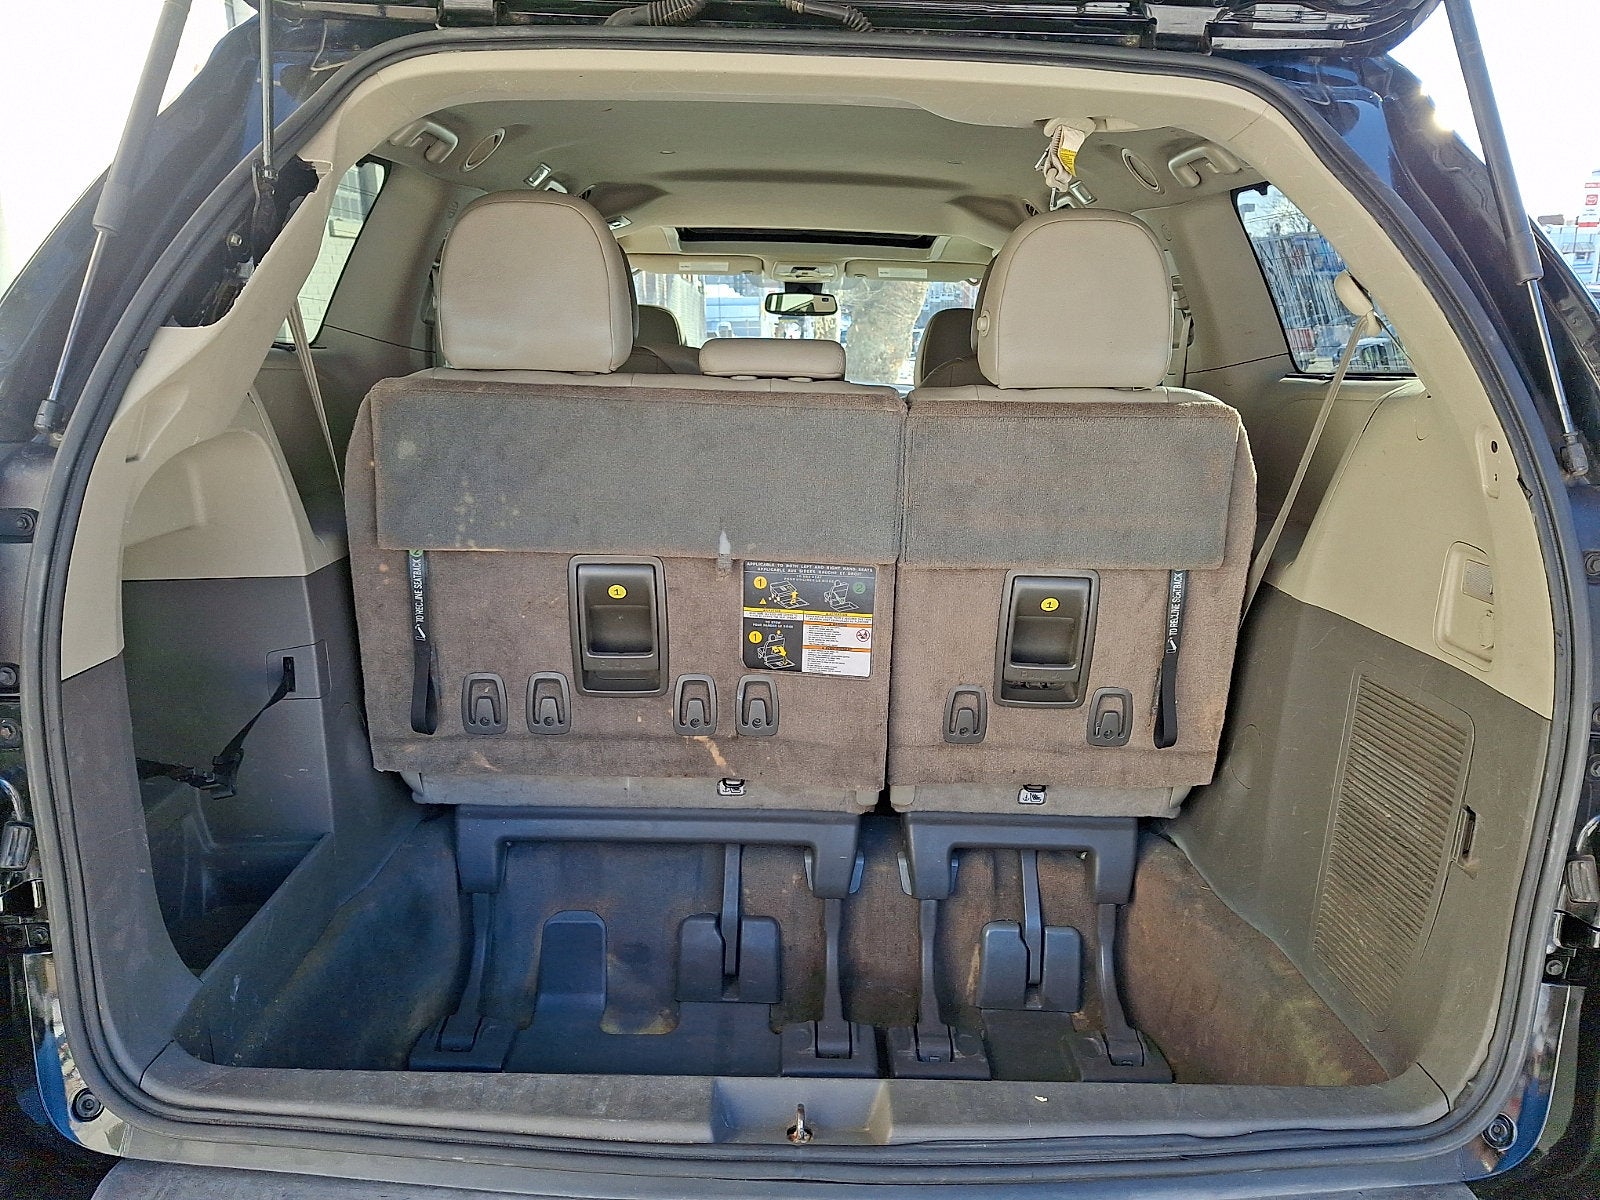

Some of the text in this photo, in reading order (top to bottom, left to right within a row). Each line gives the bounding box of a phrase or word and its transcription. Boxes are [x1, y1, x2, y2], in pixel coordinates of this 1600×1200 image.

[412, 558, 423, 589] SEATBACK
[1172, 572, 1183, 602] SEATBACK
[415, 614, 424, 624] TO
[1169, 628, 1178, 636] TO
